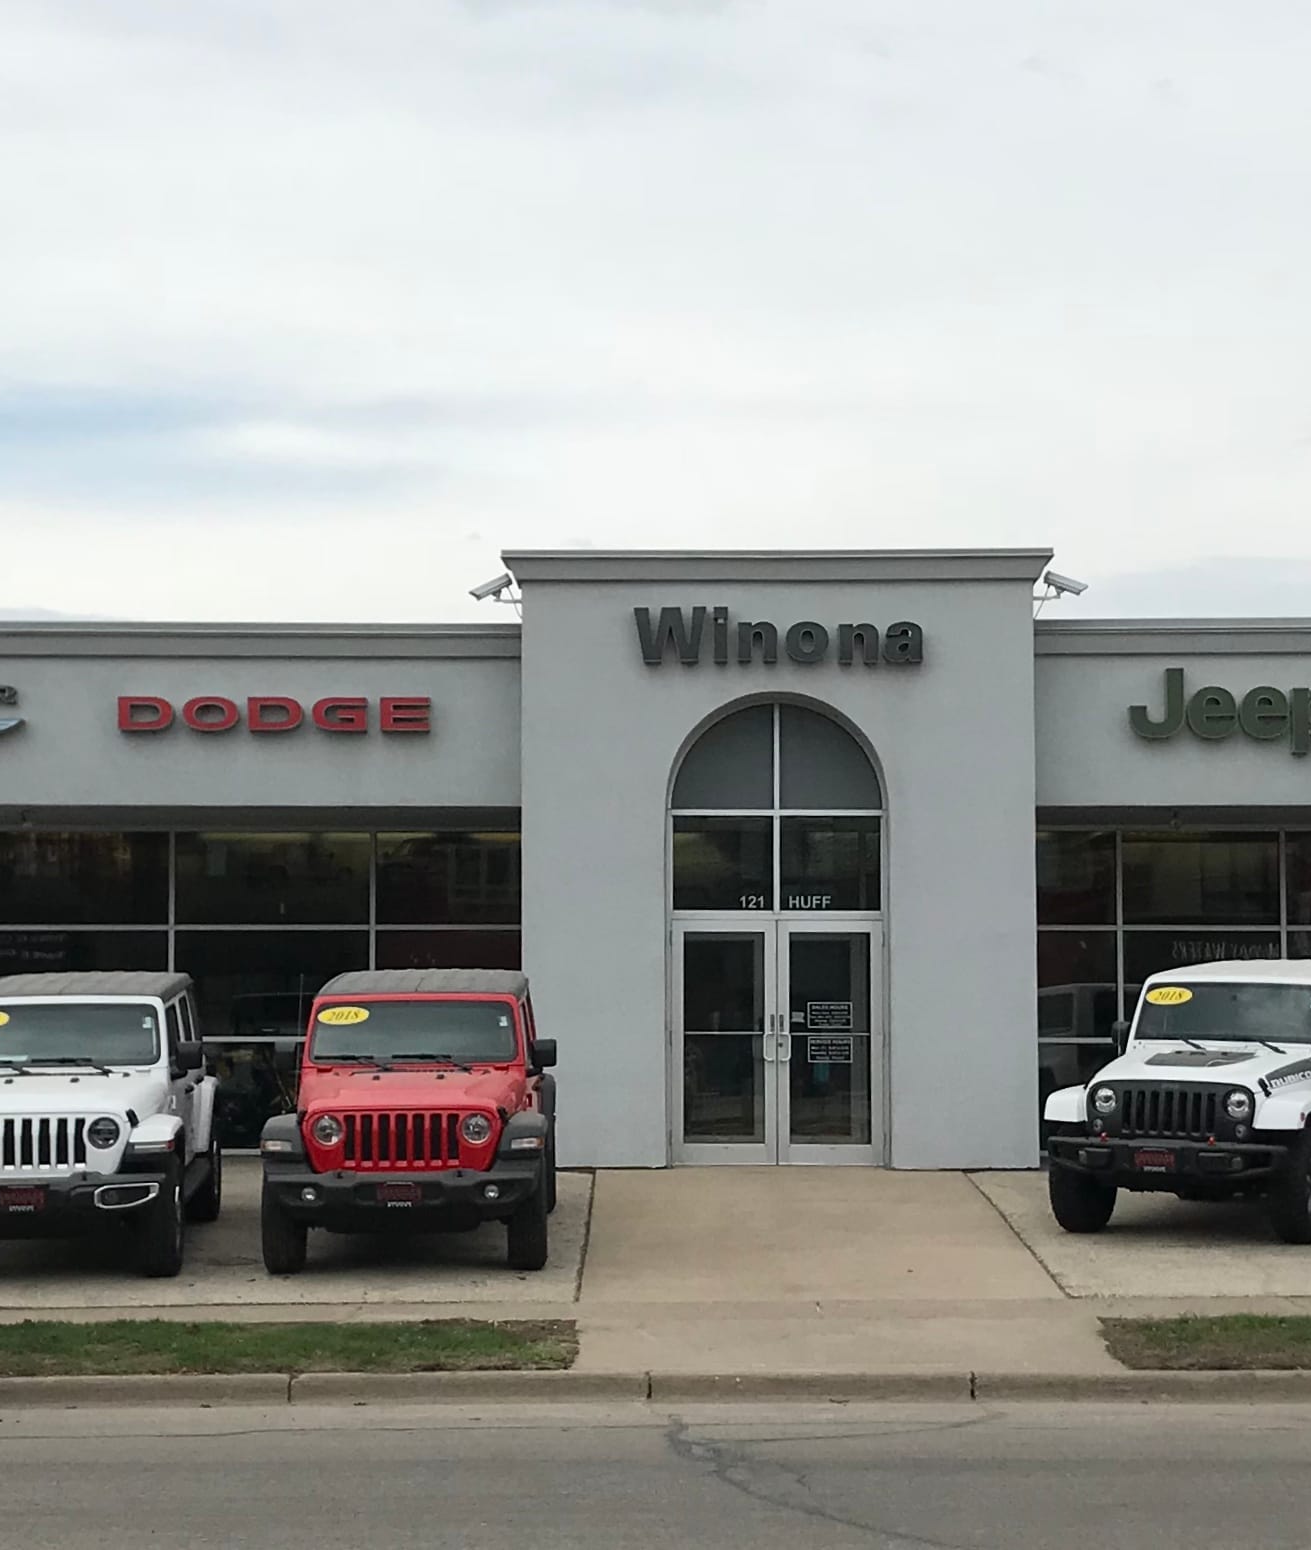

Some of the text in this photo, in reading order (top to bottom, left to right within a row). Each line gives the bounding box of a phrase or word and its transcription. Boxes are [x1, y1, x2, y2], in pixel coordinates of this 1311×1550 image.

[634, 606, 924, 664] Winona
[118, 696, 432, 732] DODGE
[739, 895, 832, 909] 121 HUFF
[1154, 991, 1187, 1001] 2018
[328, 1010, 362, 1021] 2018
